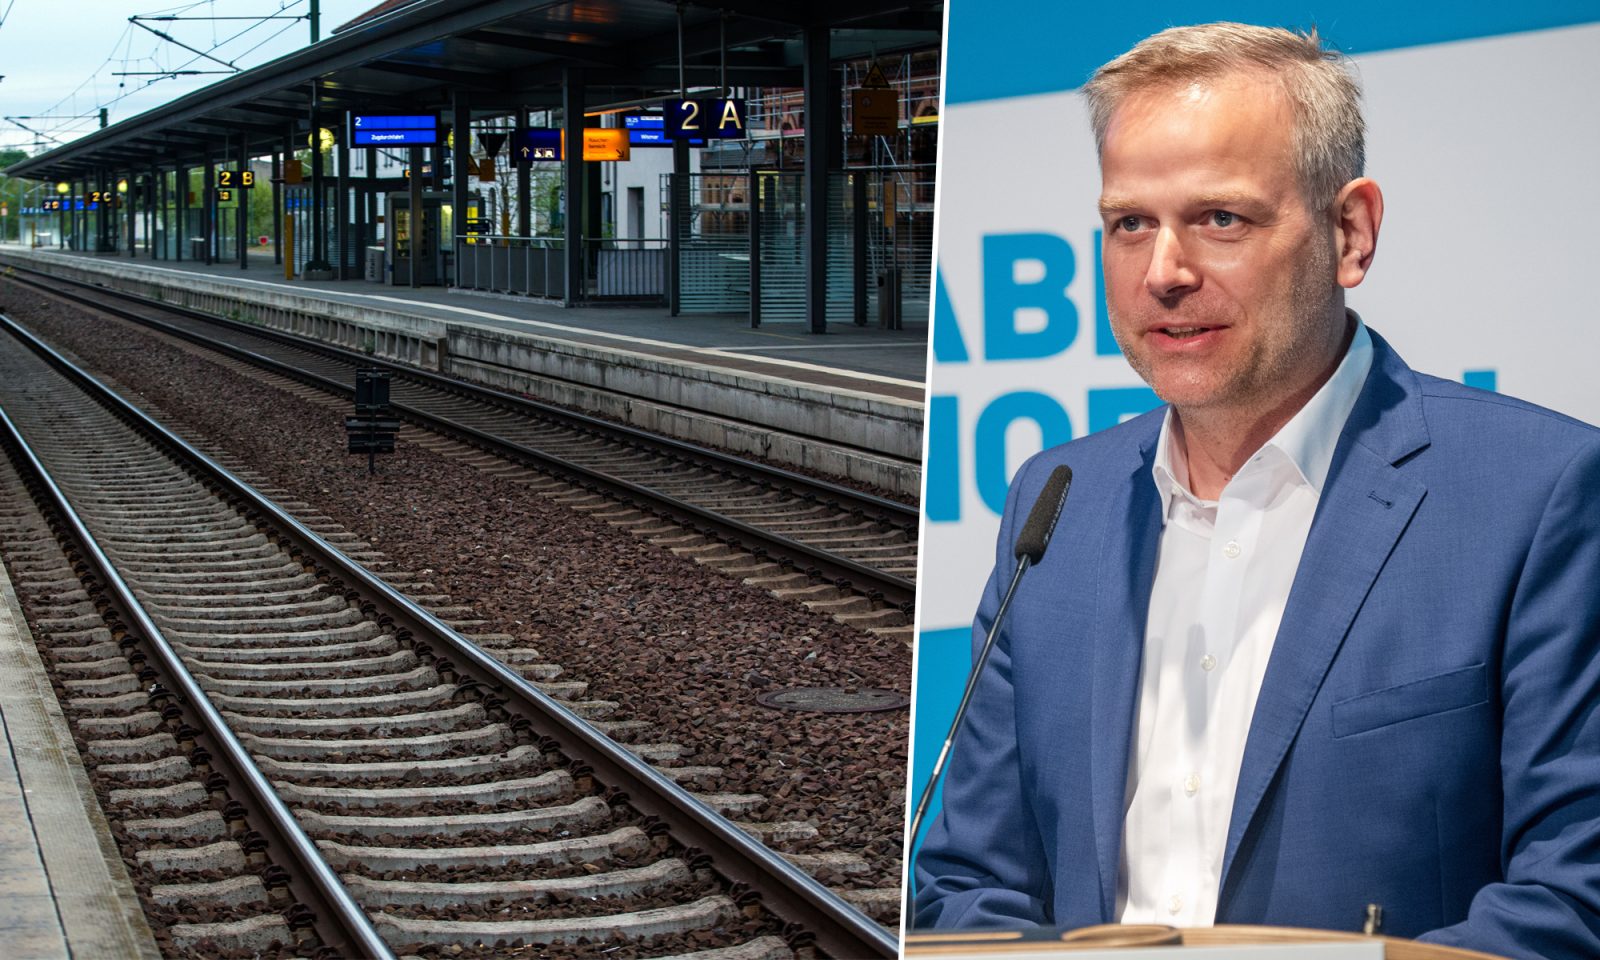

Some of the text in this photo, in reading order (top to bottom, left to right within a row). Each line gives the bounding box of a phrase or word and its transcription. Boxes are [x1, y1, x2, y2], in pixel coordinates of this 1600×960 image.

[681, 100, 742, 130] 2 A
[354, 116, 362, 127] 2
[220, 171, 253, 185] 2 B
[92, 192, 112, 202] 2 C
